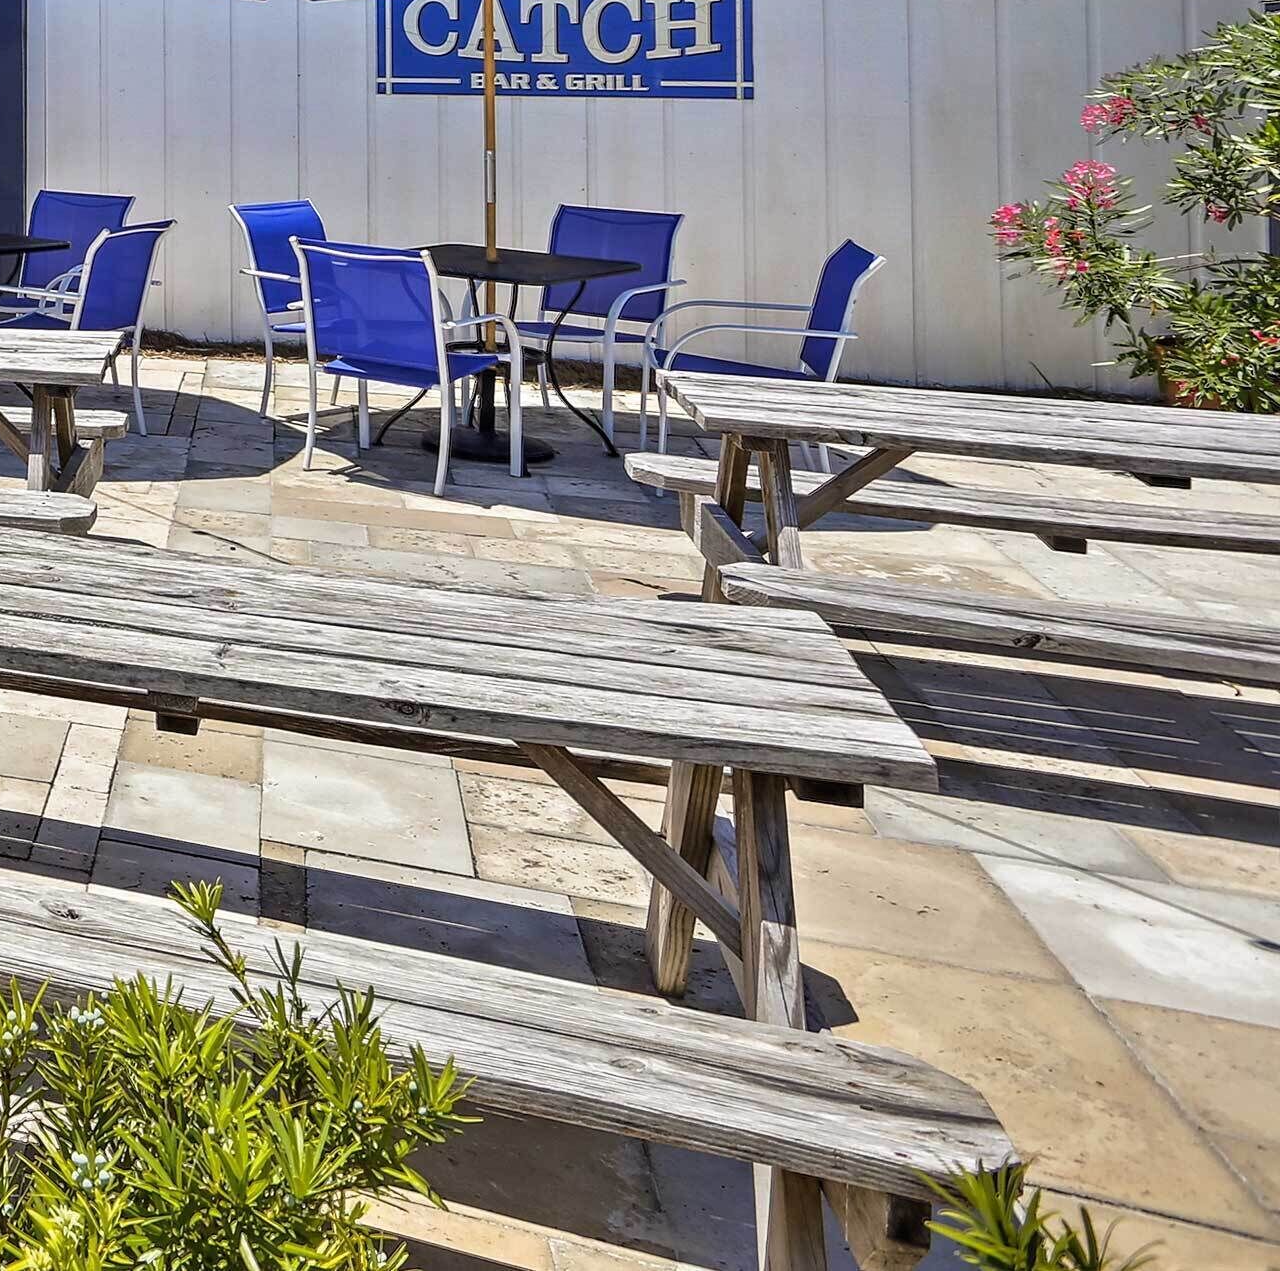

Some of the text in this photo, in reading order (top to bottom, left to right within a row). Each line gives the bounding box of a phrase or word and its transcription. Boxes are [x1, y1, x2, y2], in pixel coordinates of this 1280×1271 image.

[470, 73, 650, 92] BAR & GRILL
